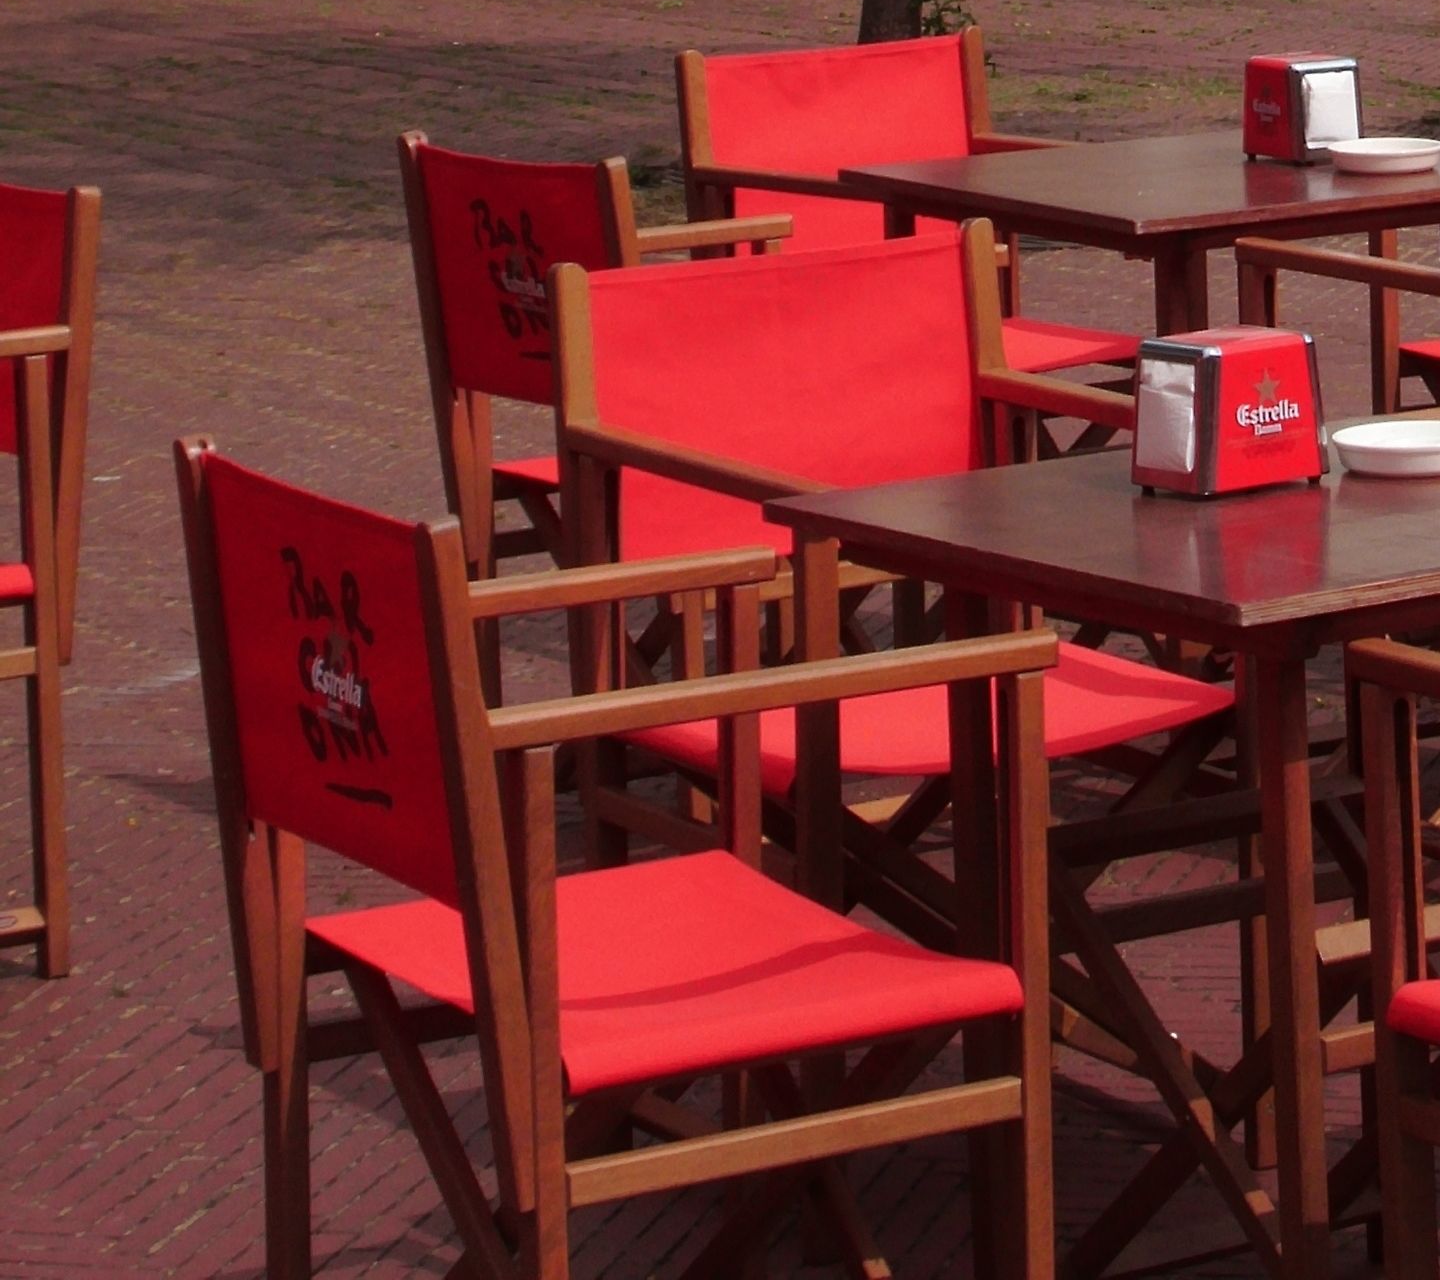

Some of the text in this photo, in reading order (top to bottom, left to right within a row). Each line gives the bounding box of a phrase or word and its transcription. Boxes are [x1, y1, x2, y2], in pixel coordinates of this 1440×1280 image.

[1236, 398, 1300, 427] Estrella
[280, 546, 374, 646] BAR
[311, 654, 362, 709] Estrella
